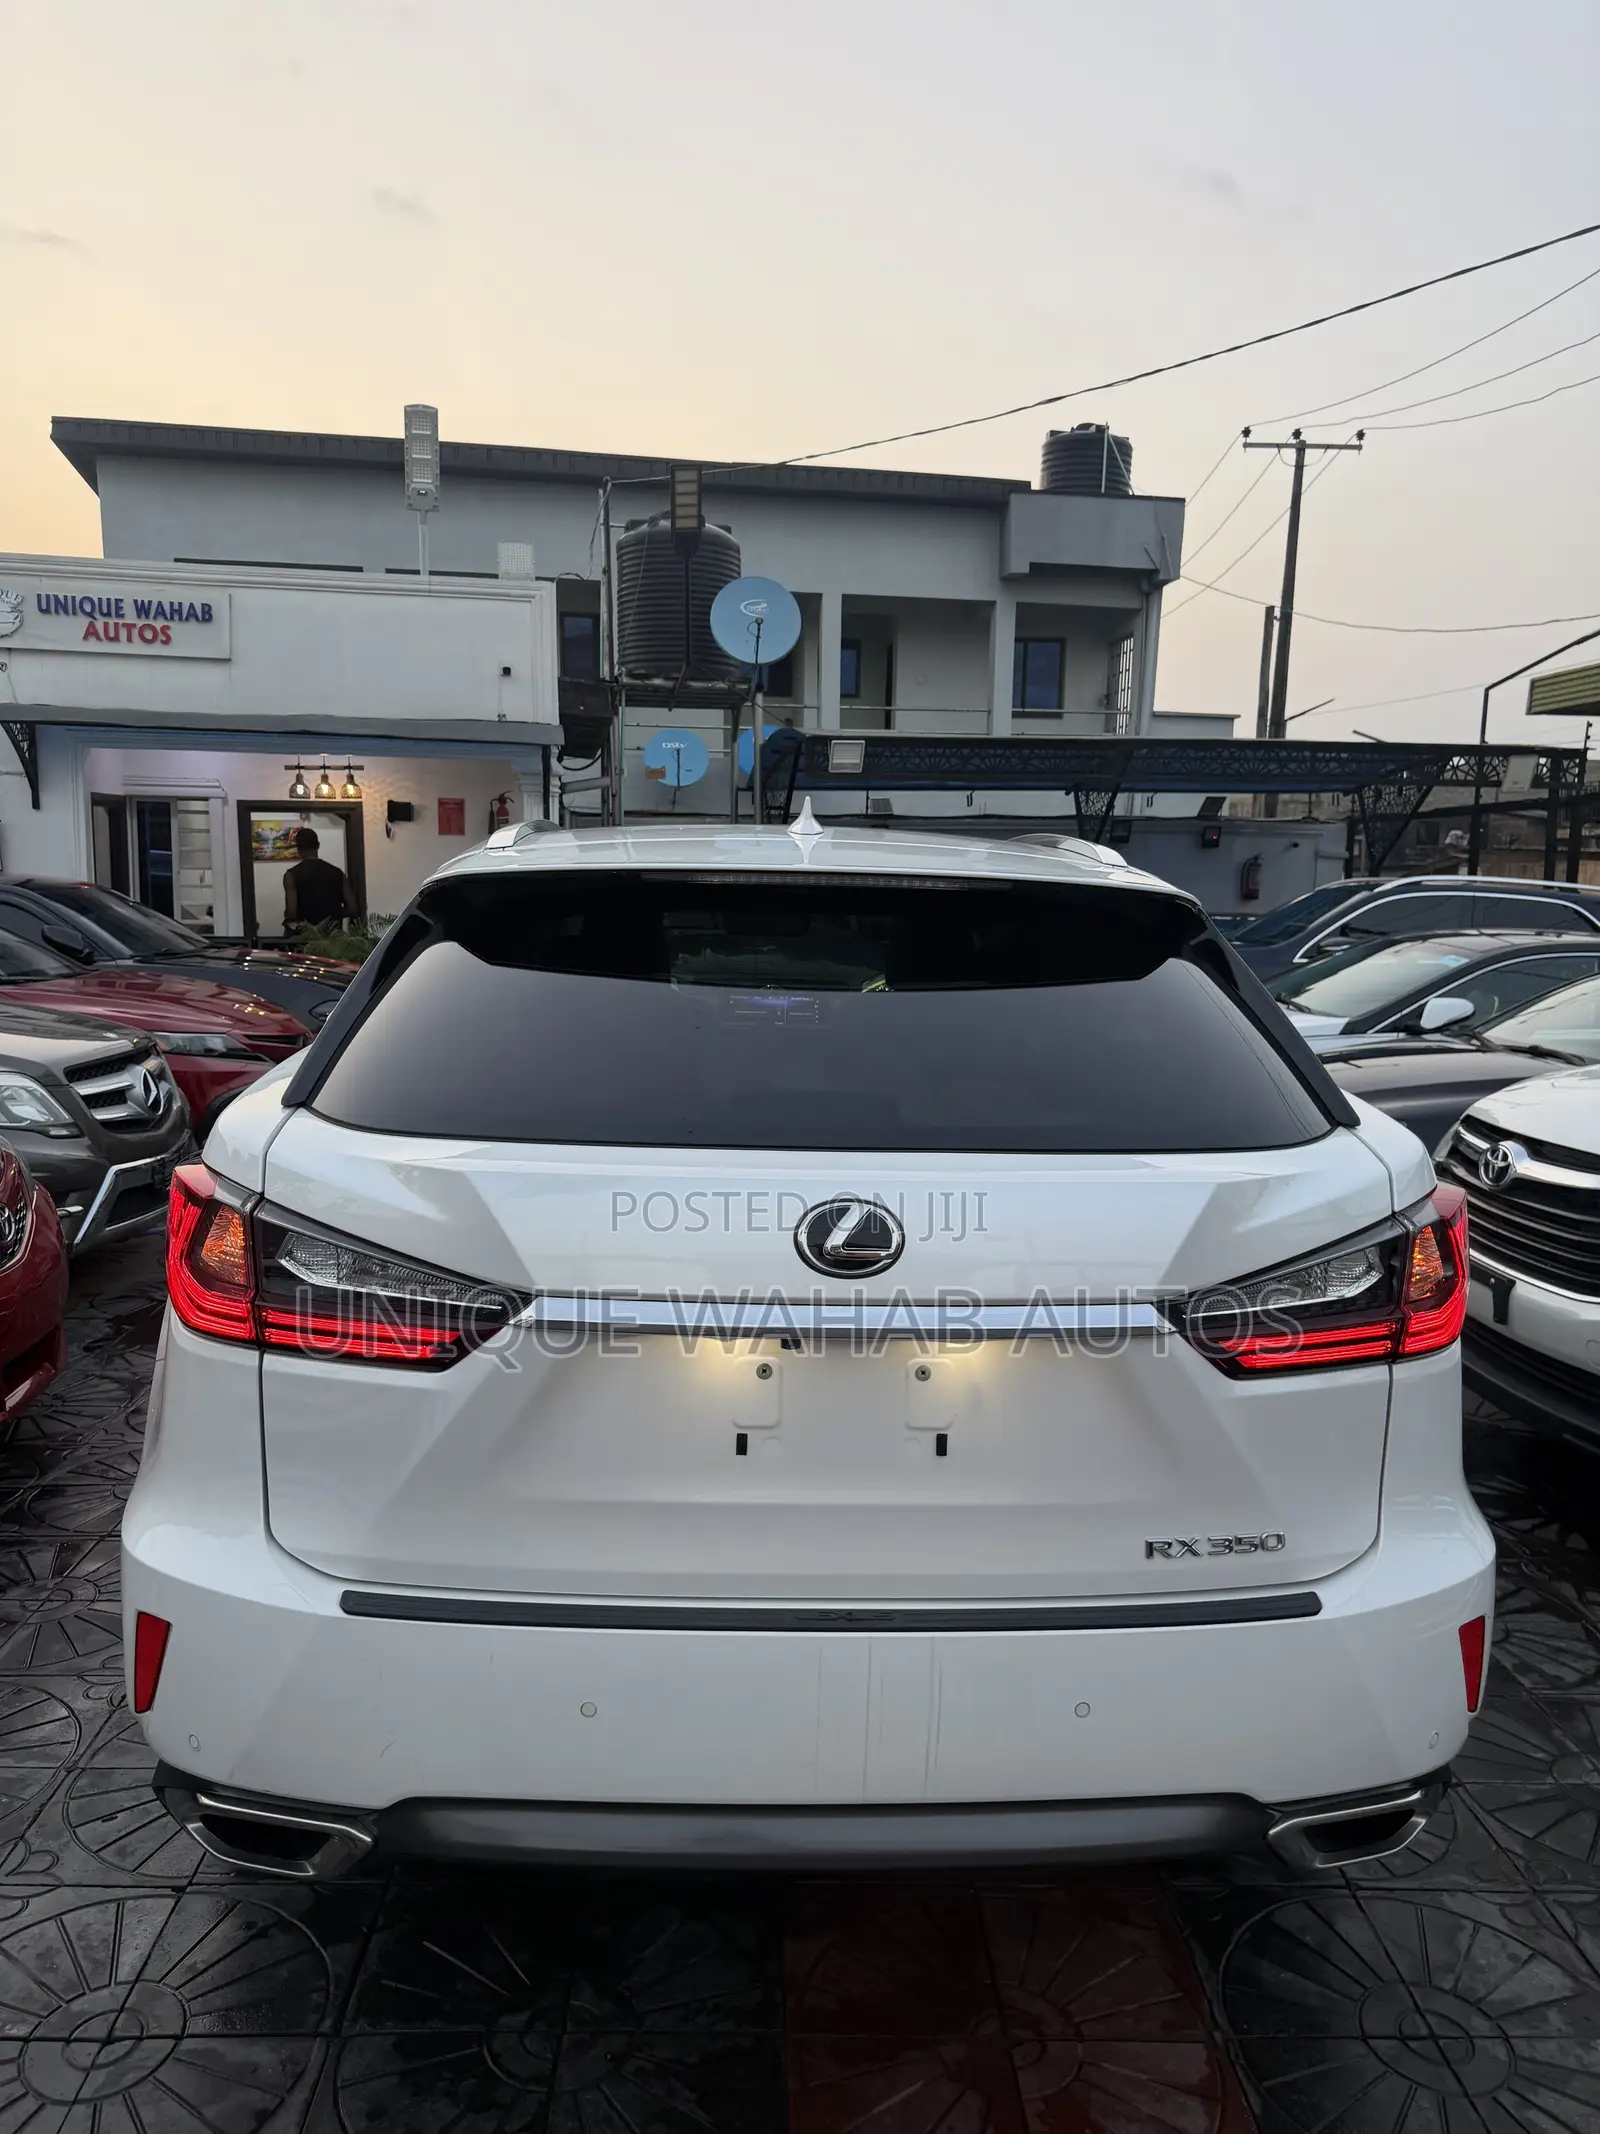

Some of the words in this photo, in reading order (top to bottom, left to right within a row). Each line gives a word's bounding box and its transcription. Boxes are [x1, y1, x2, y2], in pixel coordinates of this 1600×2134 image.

[36, 592, 126, 621] UNIQUE
[132, 598, 213, 623] WAHAB
[82, 620, 172, 645] AUTOS
[1145, 1535, 1204, 1559] RX
[1207, 1530, 1286, 1556] 350
